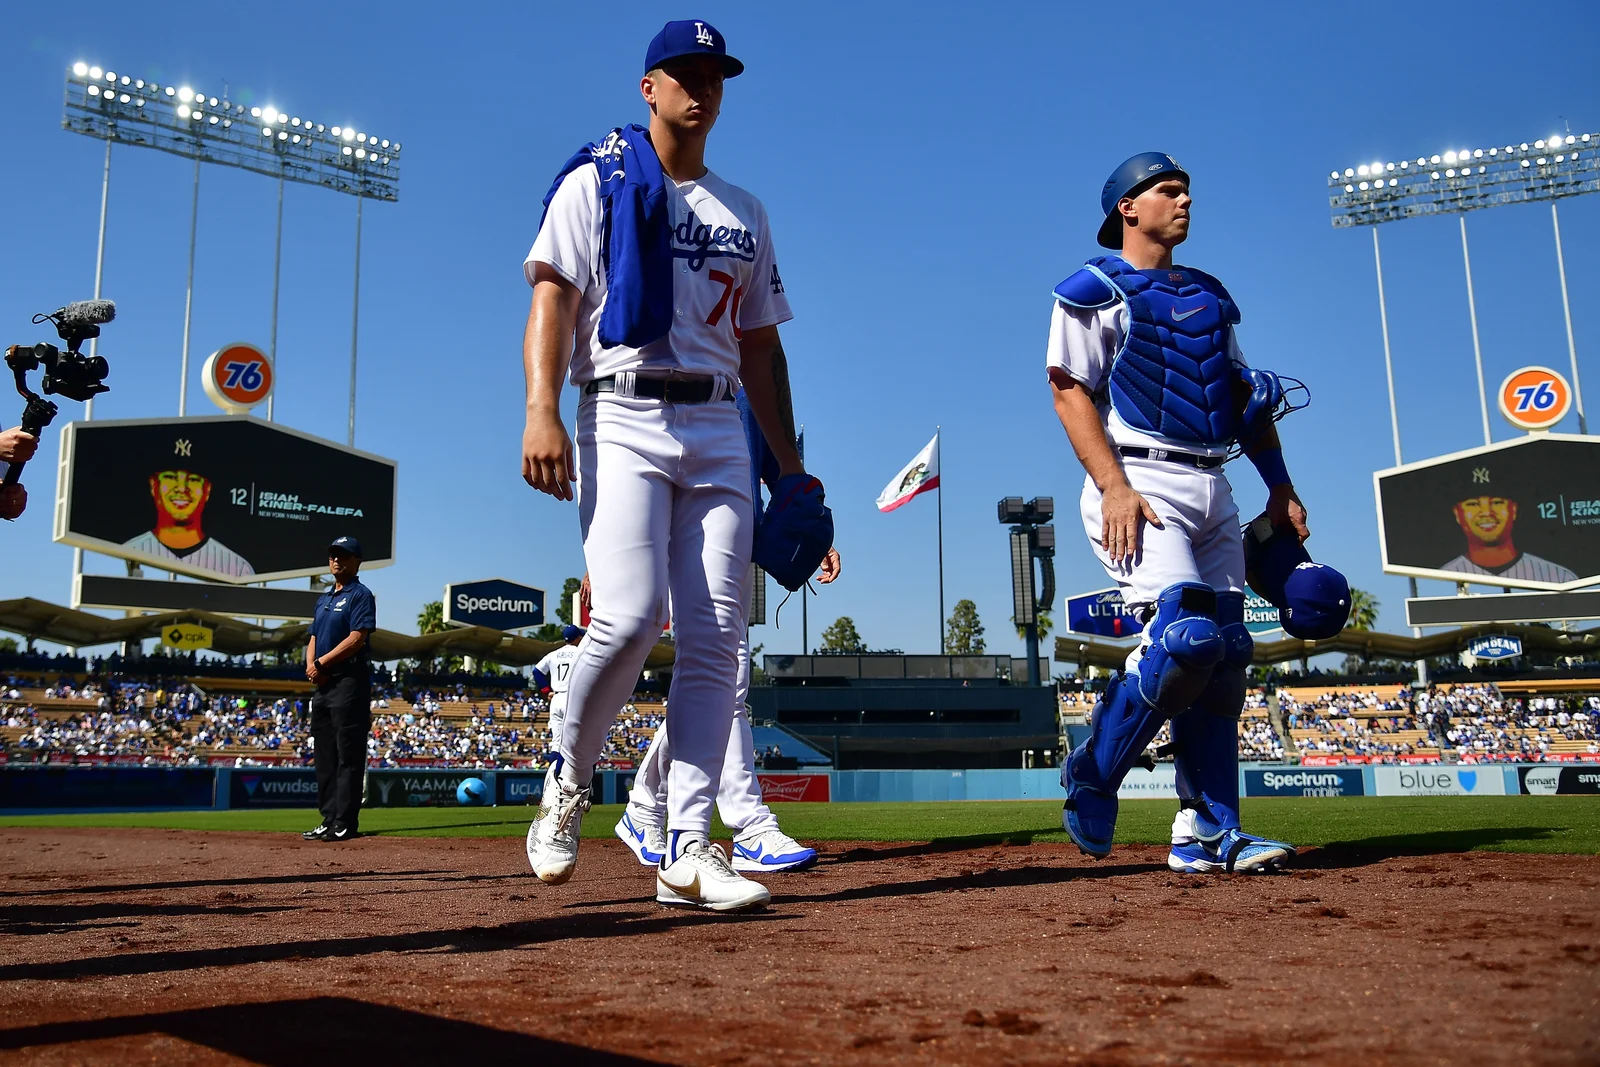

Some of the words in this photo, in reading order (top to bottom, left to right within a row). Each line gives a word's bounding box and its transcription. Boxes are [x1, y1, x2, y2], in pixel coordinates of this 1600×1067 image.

[694, 22, 714, 46] LA
[223, 361, 264, 391] 76
[1512, 380, 1558, 413] 76
[230, 487, 248, 506] 12
[259, 491, 299, 503] ISIAH
[1570, 500, 1600, 510] ISIA
[258, 499, 364, 518] KINER-FALEFA
[1537, 502, 1558, 519] 12
[456, 593, 533, 614] Spectrum
[1088, 603, 1132, 617] ULTR
[1490, 637, 1518, 653] BEAM
[557, 662, 570, 682] 17
[262, 777, 319, 793] vividse
[761, 782, 805, 794] Budweiser
[1263, 771, 1339, 791] Spectrum
[1400, 770, 1452, 789] blue
[1526, 777, 1557, 786] smart
[510, 783, 541, 796] UCLA
